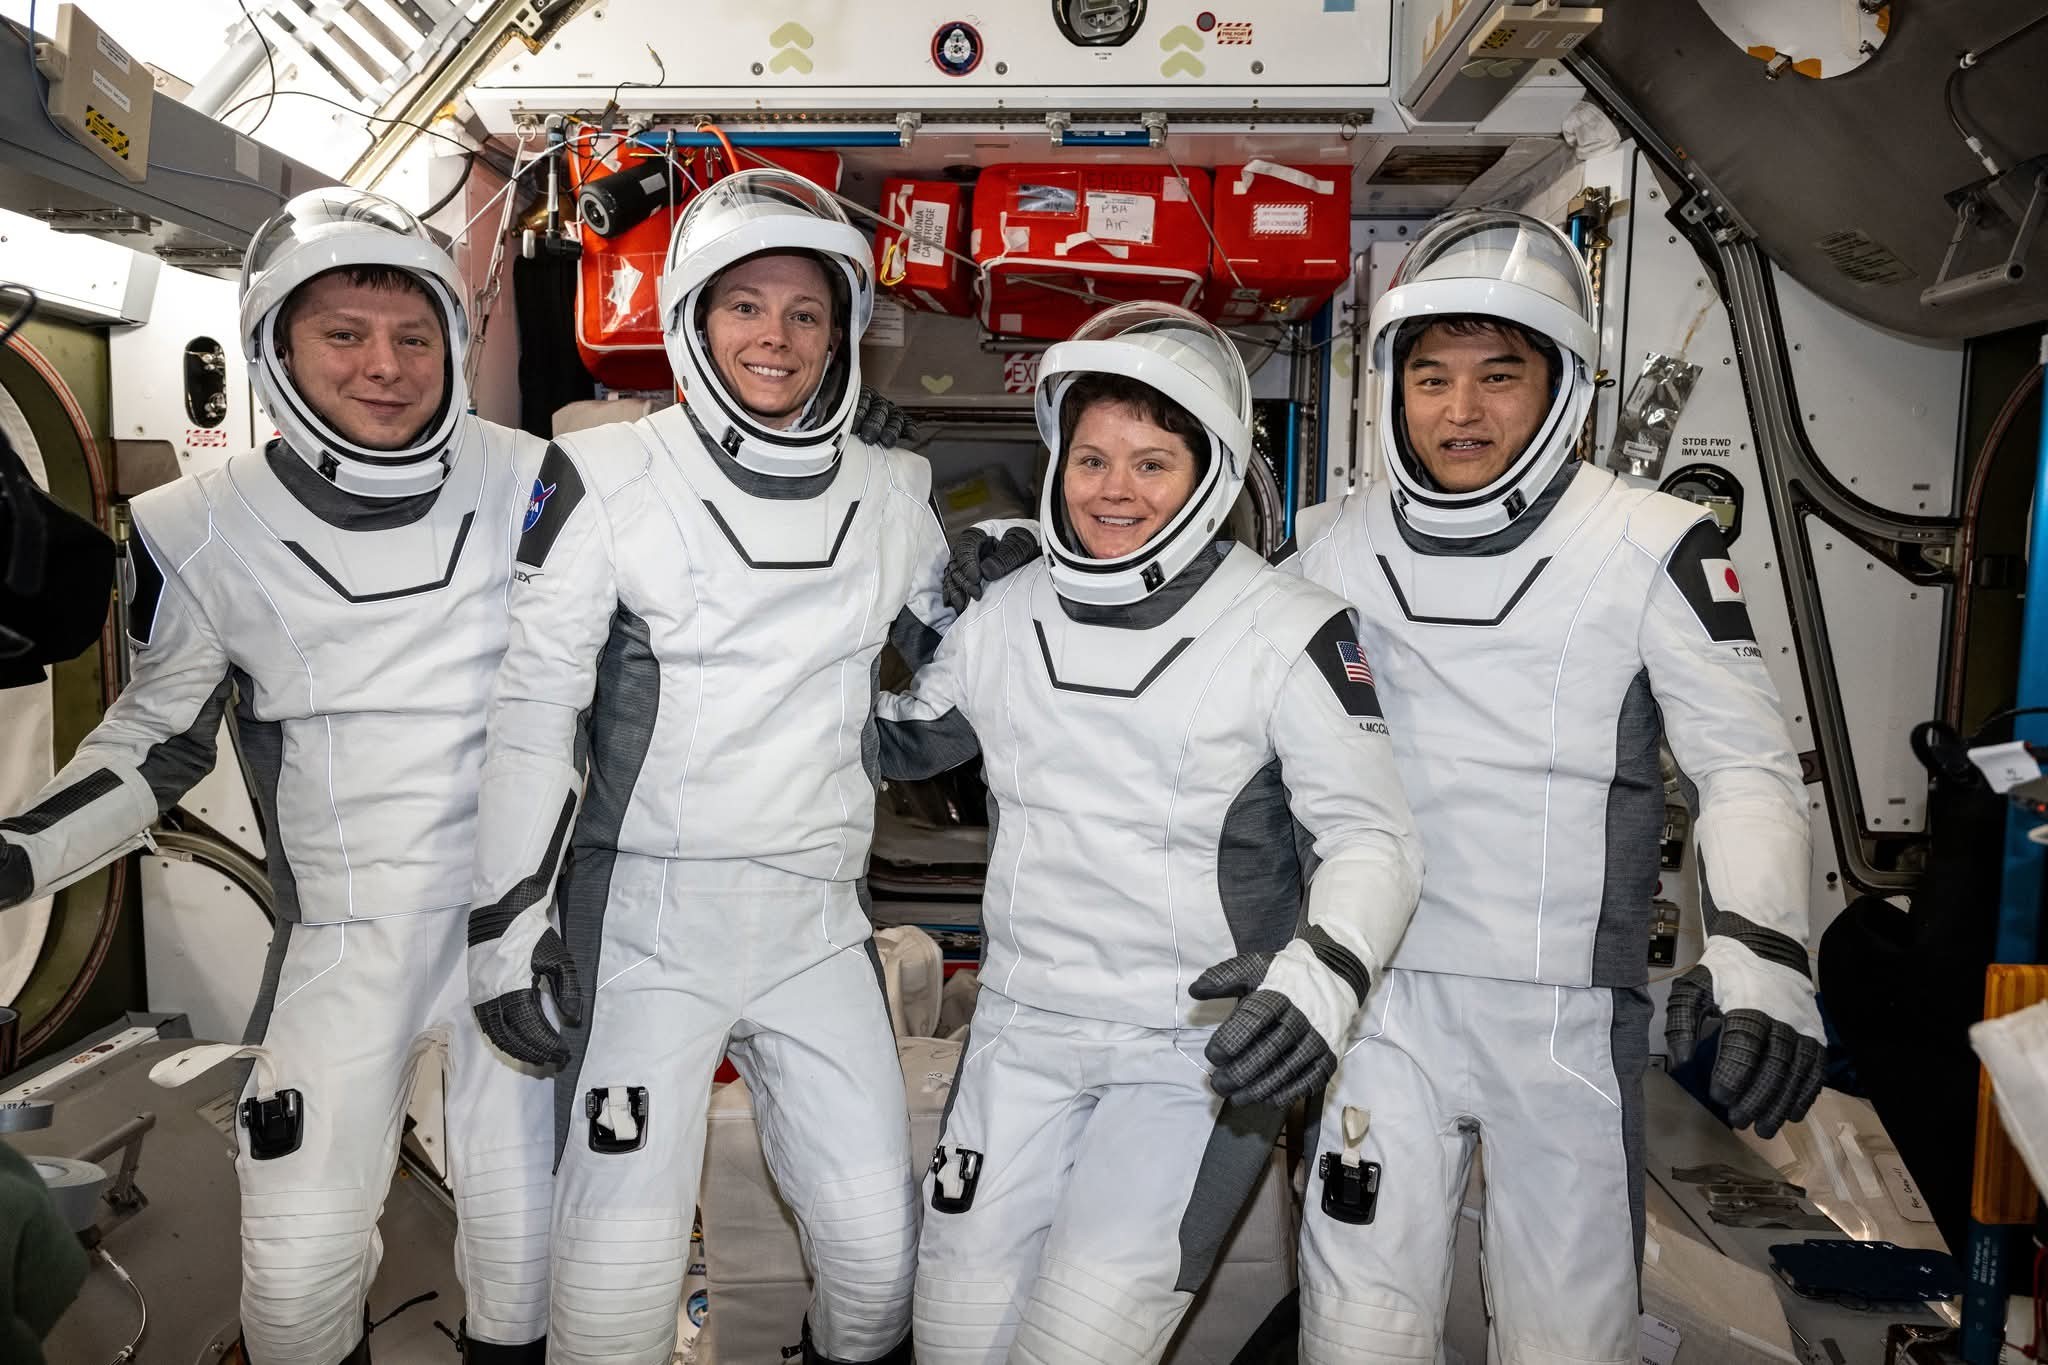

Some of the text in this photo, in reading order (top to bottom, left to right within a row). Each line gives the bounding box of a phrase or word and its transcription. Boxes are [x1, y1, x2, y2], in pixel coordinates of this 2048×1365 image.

[1682, 438, 1732, 447] STDB FWD
[1681, 448, 1731, 457] IMV VALVE
